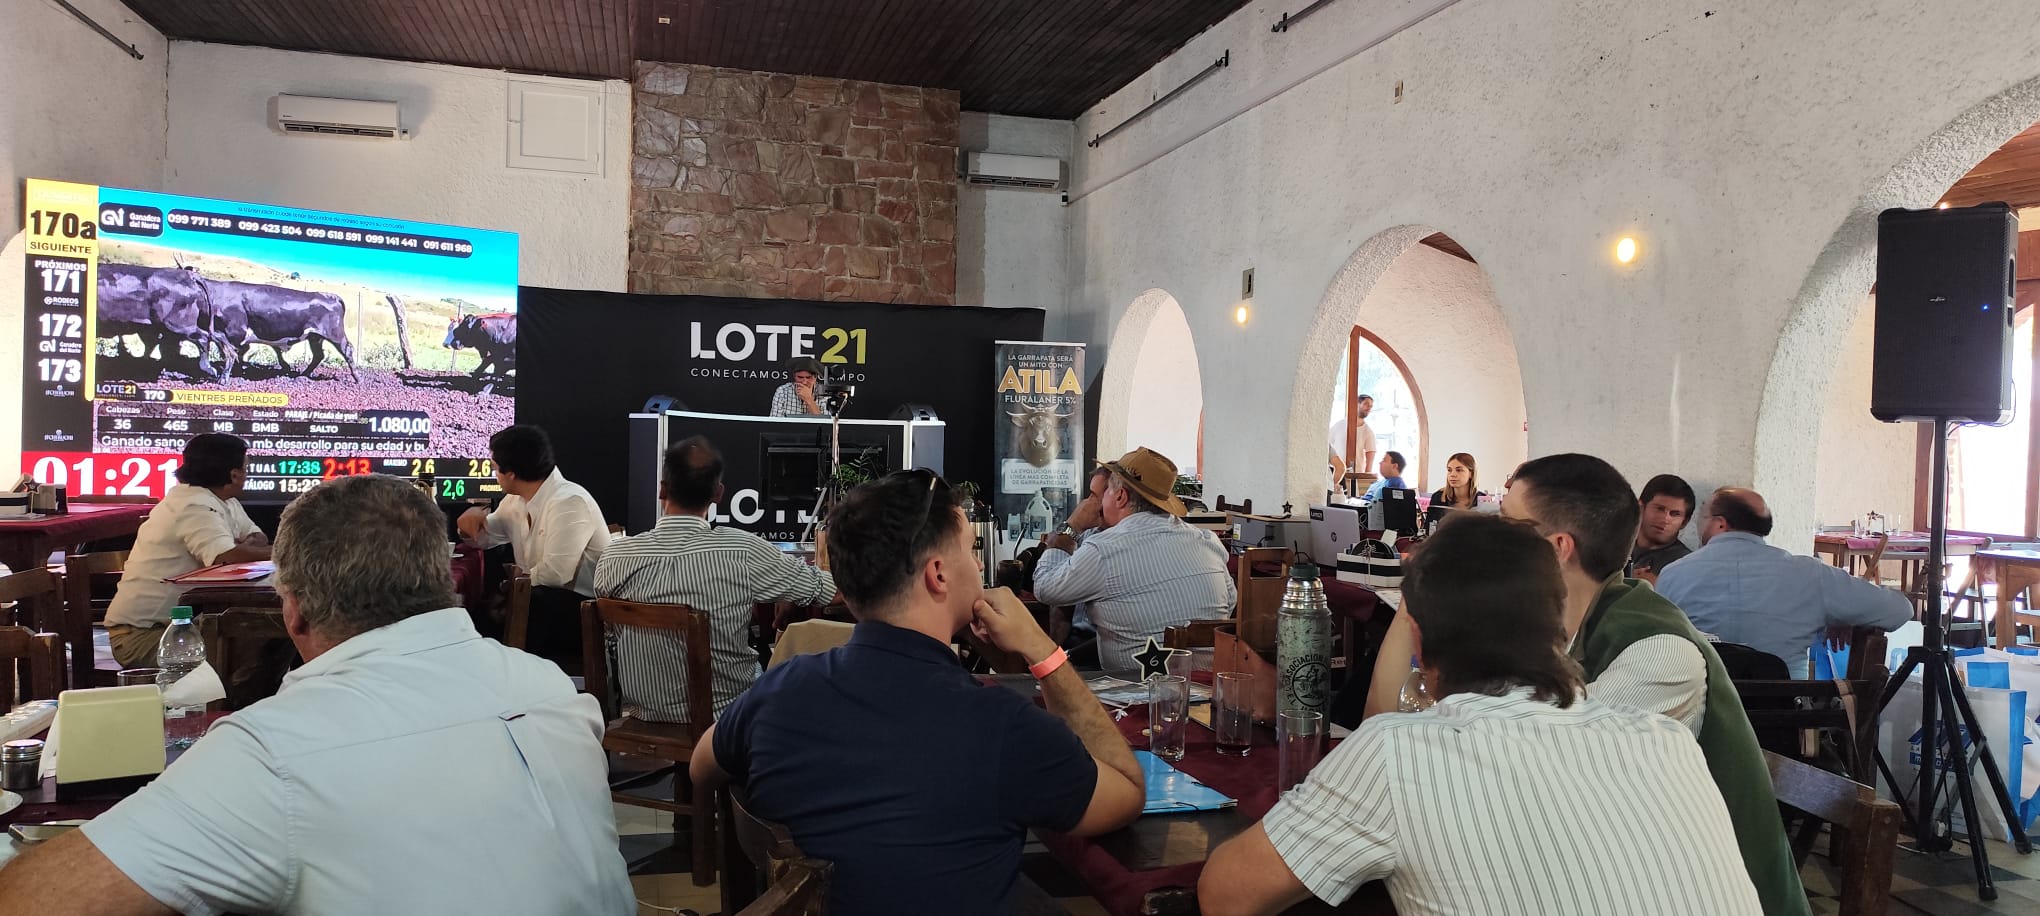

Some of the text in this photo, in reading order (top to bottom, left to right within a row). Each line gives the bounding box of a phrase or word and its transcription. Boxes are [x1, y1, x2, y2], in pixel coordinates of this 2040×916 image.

[129, 212, 161, 223] Ganadera
[30, 209, 97, 240] 170a
[141, 222, 160, 230] Norte
[167, 213, 473, 254] 099 771 389 099 423 504 099 618 591 099 141 441 091 611 968
[30, 241, 92, 254] SIGUIENTE
[34, 259, 87, 271] PRÓXIMOS
[41, 268, 80, 294] 171
[52, 296, 80, 305] RODEOS
[39, 313, 82, 338] 172
[1017, 354, 1056, 362] GARRAPATA
[1056, 354, 1074, 362] SERÁ
[38, 358, 81, 383] 173
[690, 367, 789, 380] CONECTAMOS
[997, 365, 1082, 395] ATILA
[96, 383, 137, 395] LOTE21
[144, 390, 166, 400] 170
[176, 392, 283, 404] VIENTRES PREÑADOS
[1004, 395, 1077, 404] FLURALANER 5%
[105, 406, 141, 414] Cabezas
[212, 409, 234, 417] Clase
[252, 410, 279, 418] Estado
[313, 410, 335, 420] Picada
[335, 412, 344, 420] de
[113, 418, 132, 430] 36
[163, 420, 188, 431] 465
[213, 422, 234, 432] MB
[252, 422, 280, 433] BMB
[309, 425, 339, 434] SALTO
[368, 417, 430, 436] 1.080,00
[101, 436, 152, 447] Ganado
[154, 437, 186, 448] sano
[252, 438, 274, 450] mb
[275, 439, 332, 451] desarrollo
[333, 442, 359, 454] para
[360, 443, 374, 451] su
[376, 441, 404, 451] edad
[405, 443, 412, 454] y
[245, 463, 277, 473] TUAL
[278, 460, 321, 475] 17:38
[468, 459, 491, 479] 2,6
[442, 480, 465, 500] 2,6
[1149, 656, 1160, 667] 6
